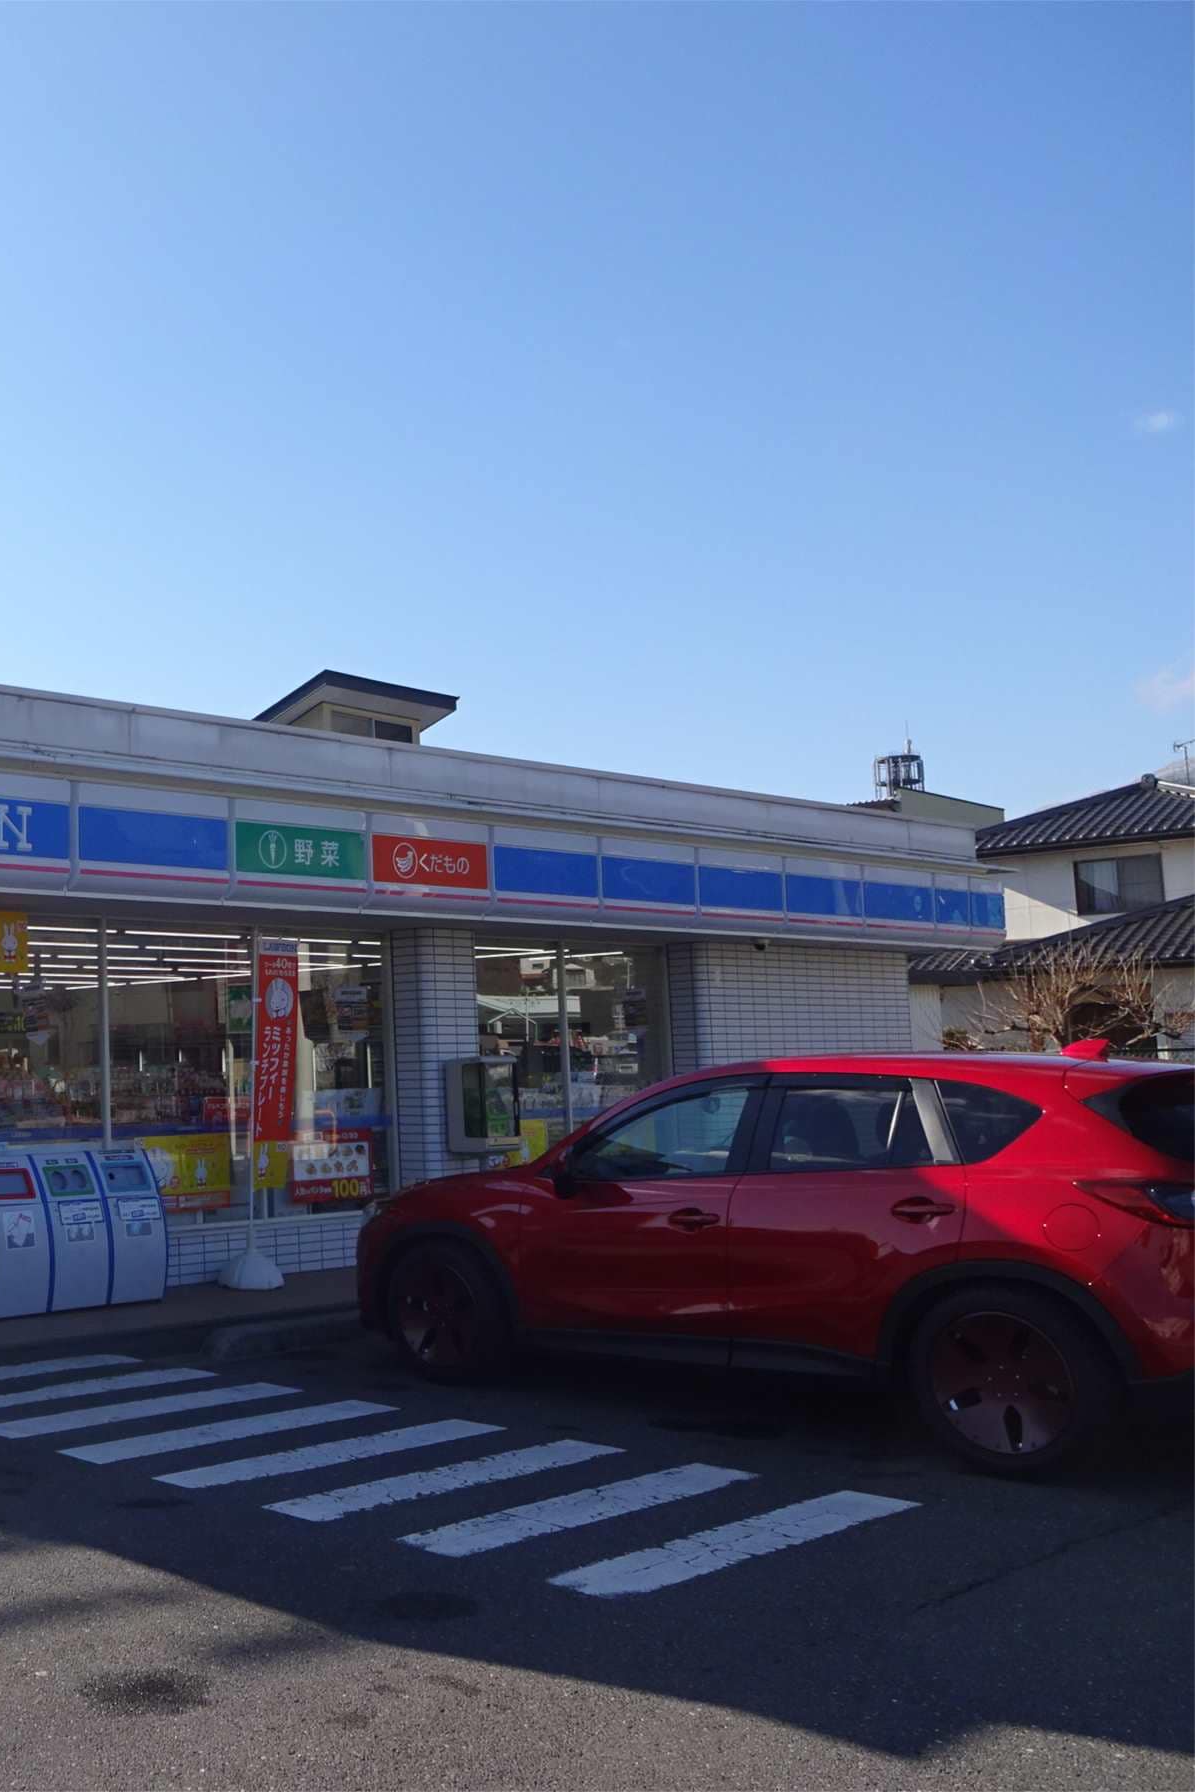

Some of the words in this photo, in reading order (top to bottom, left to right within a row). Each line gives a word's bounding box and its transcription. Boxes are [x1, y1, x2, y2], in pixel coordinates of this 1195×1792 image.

[293, 839, 341, 867] 野菜
[417, 854, 471, 877] くだもの
[267, 1026, 281, 1100] ミッフィー
